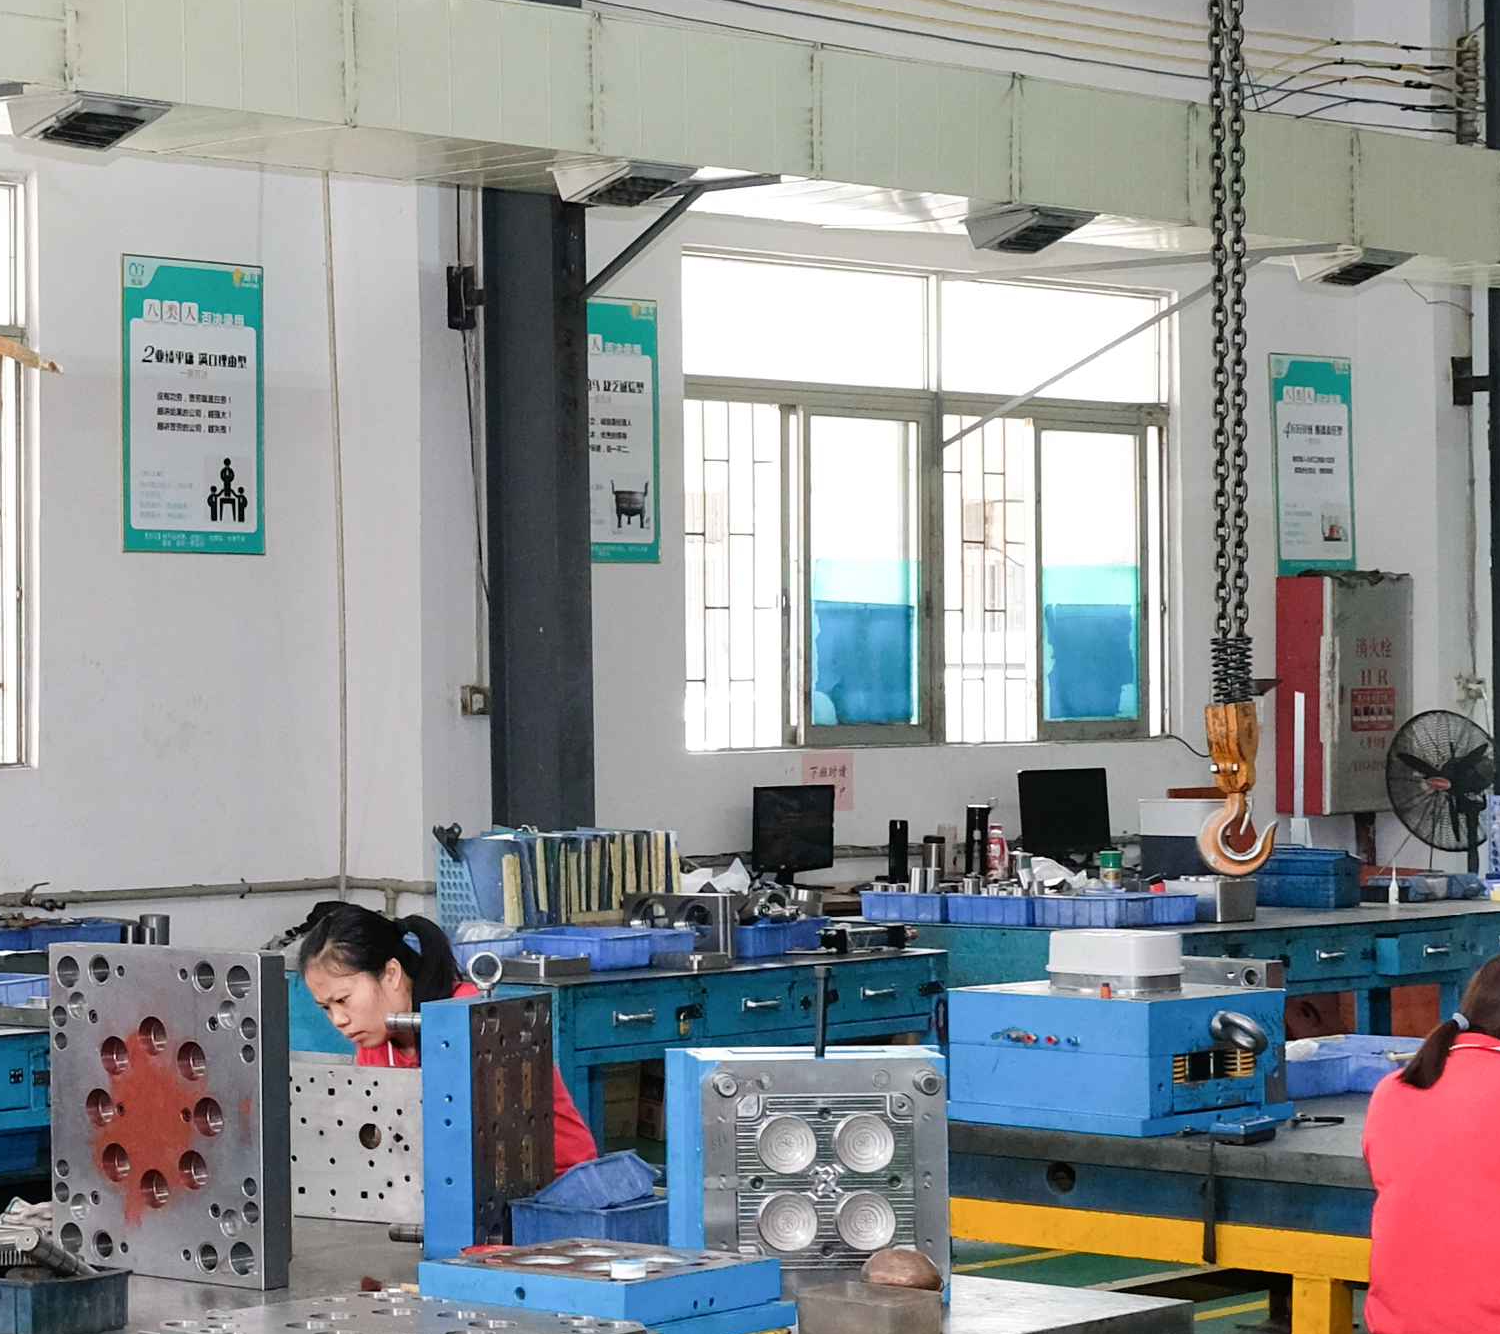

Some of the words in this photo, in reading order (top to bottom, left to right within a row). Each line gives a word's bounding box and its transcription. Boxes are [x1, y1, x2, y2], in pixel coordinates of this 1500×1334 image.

[147, 303, 196, 321] 八类人
[1355, 637, 1392, 658] 消火栓
